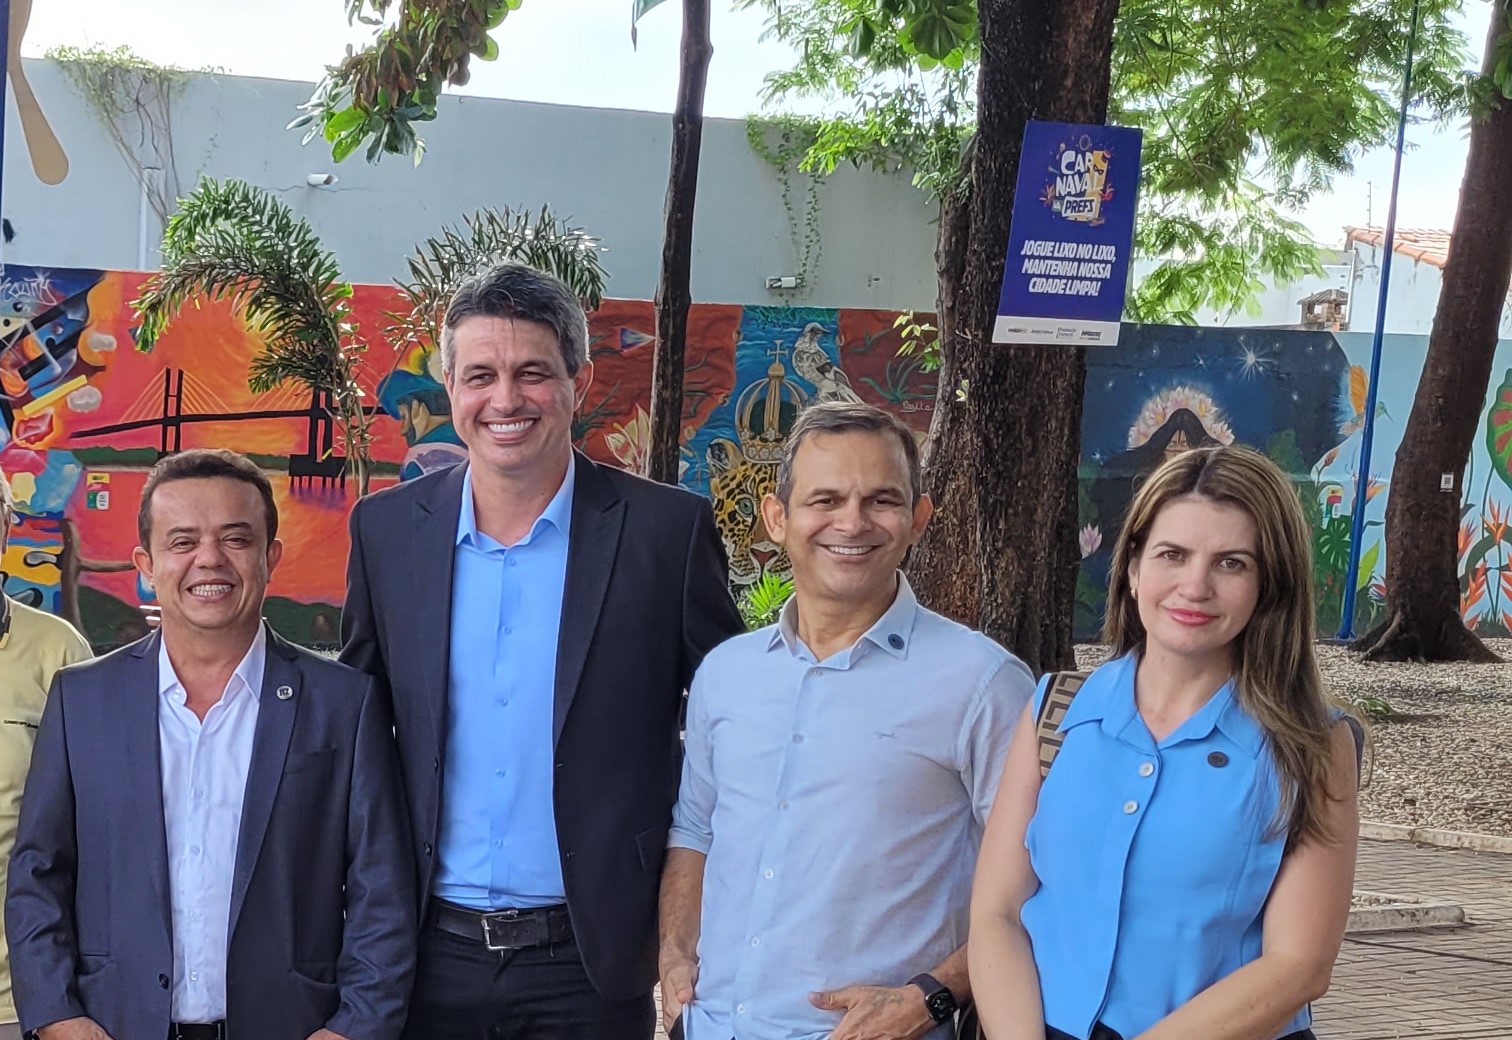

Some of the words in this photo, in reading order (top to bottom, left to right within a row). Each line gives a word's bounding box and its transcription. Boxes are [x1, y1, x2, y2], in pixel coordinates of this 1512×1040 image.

[1061, 151, 1094, 174] CAR
[1056, 172, 1102, 197] NAVAL
[1064, 199, 1095, 214] PREFS
[1021, 240, 1055, 257] JOGUE
[1053, 242, 1077, 258] LIXO
[1076, 243, 1092, 259] NO
[1092, 245, 1116, 263] LIXO,
[1022, 259, 1078, 277] MANTENHA
[1078, 262, 1111, 279] NOSSA
[1028, 277, 1066, 294] CIDADE
[1065, 280, 1101, 296] LIMPA!
